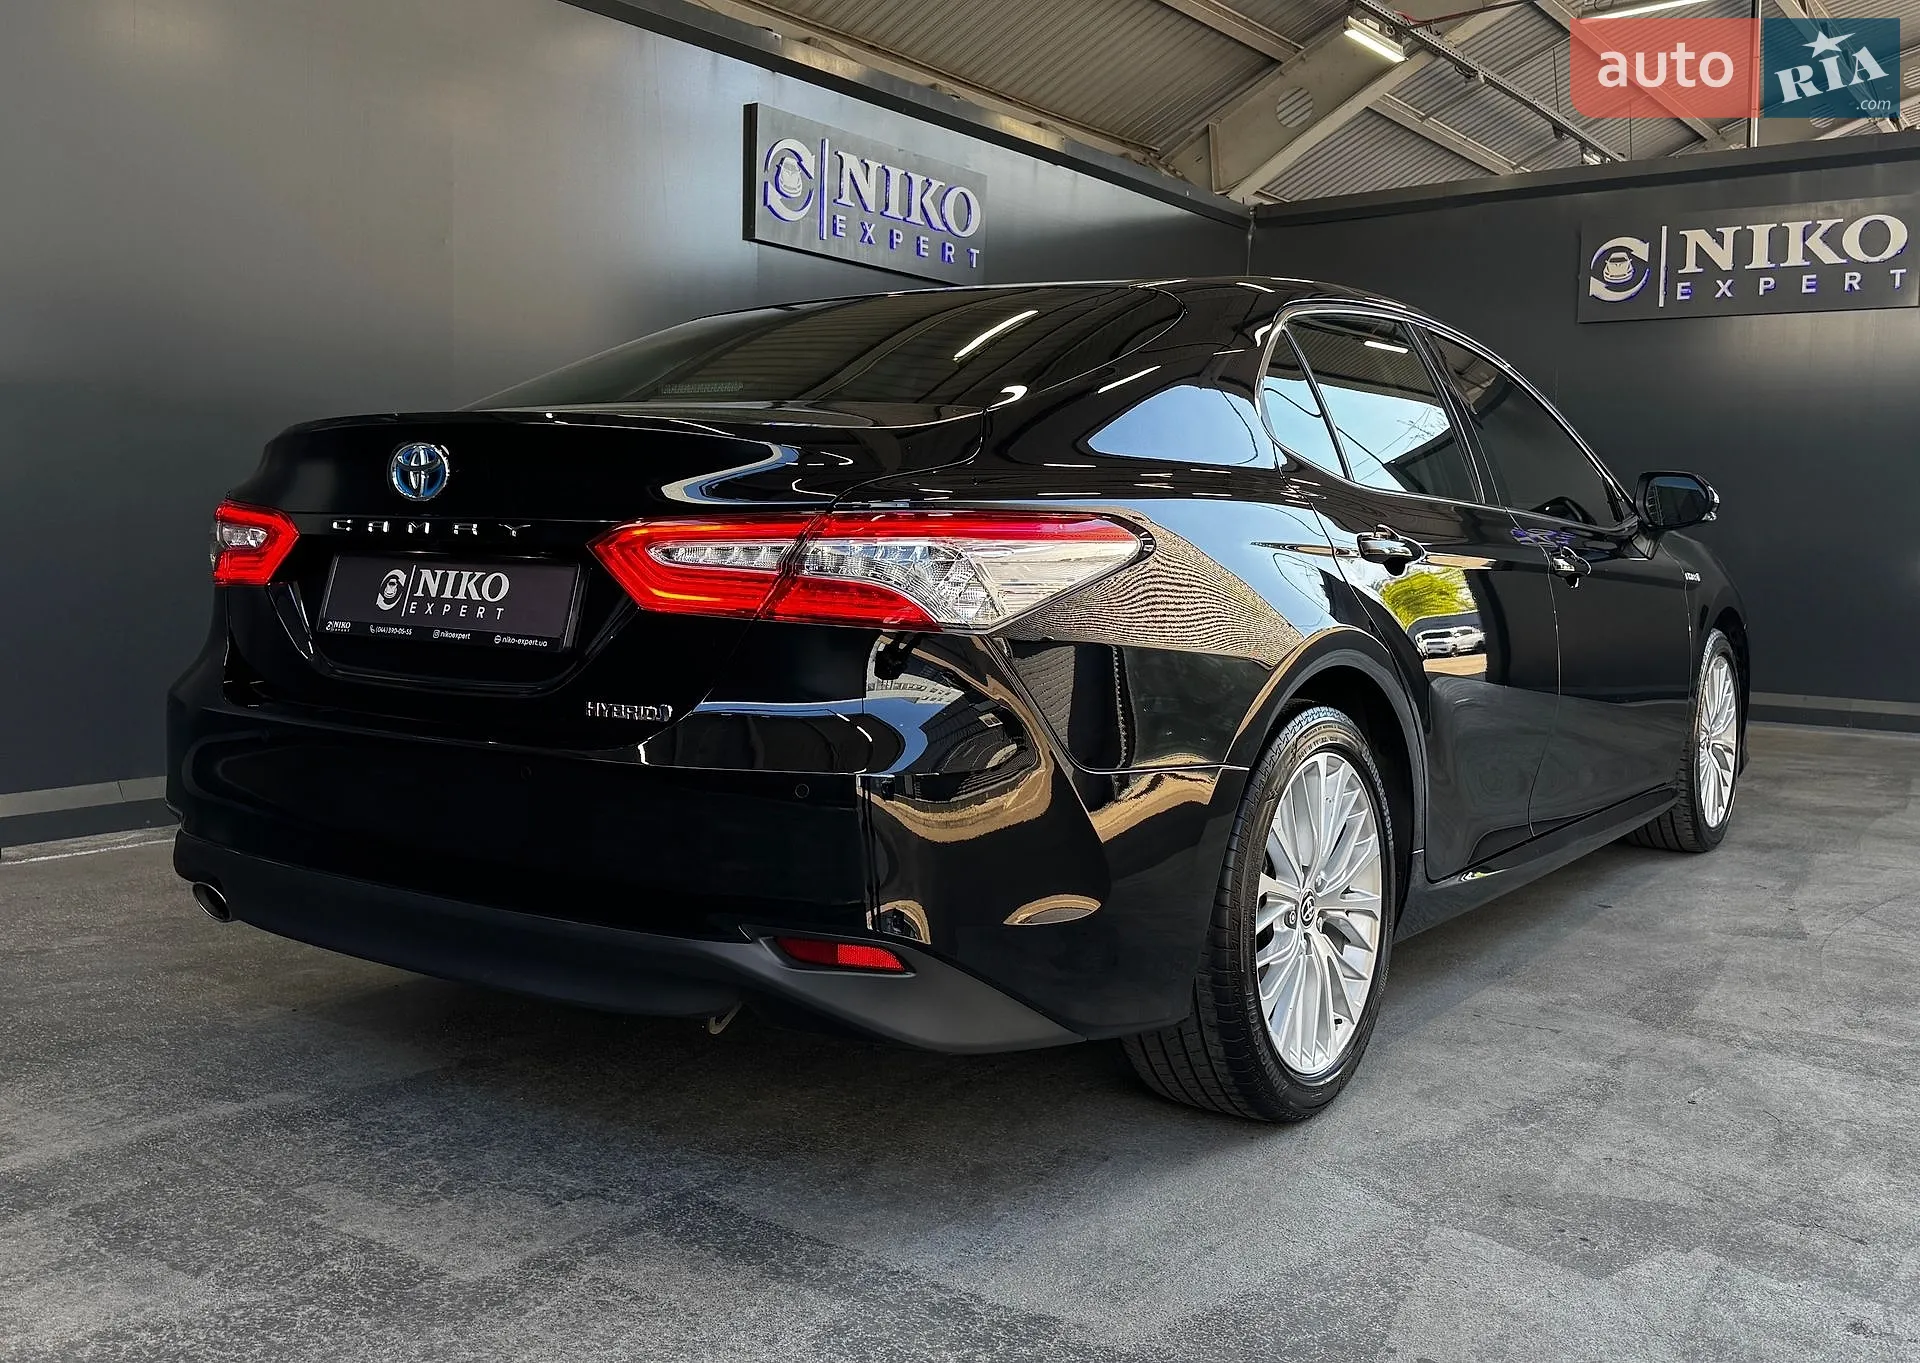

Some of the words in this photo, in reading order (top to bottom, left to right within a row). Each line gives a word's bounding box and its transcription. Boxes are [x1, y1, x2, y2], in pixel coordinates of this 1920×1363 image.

[833, 150, 981, 238] NIKO
[832, 214, 980, 268] EXPERT
[1678, 214, 1908, 274] NIKO
[1676, 269, 1907, 300] EXPERT
[332, 518, 531, 537] CAMRY
[413, 568, 510, 602] NIKO
[409, 602, 504, 620] EXPERT
[440, 630, 471, 640] nikoexpert
[586, 701, 658, 721] HYBRID
